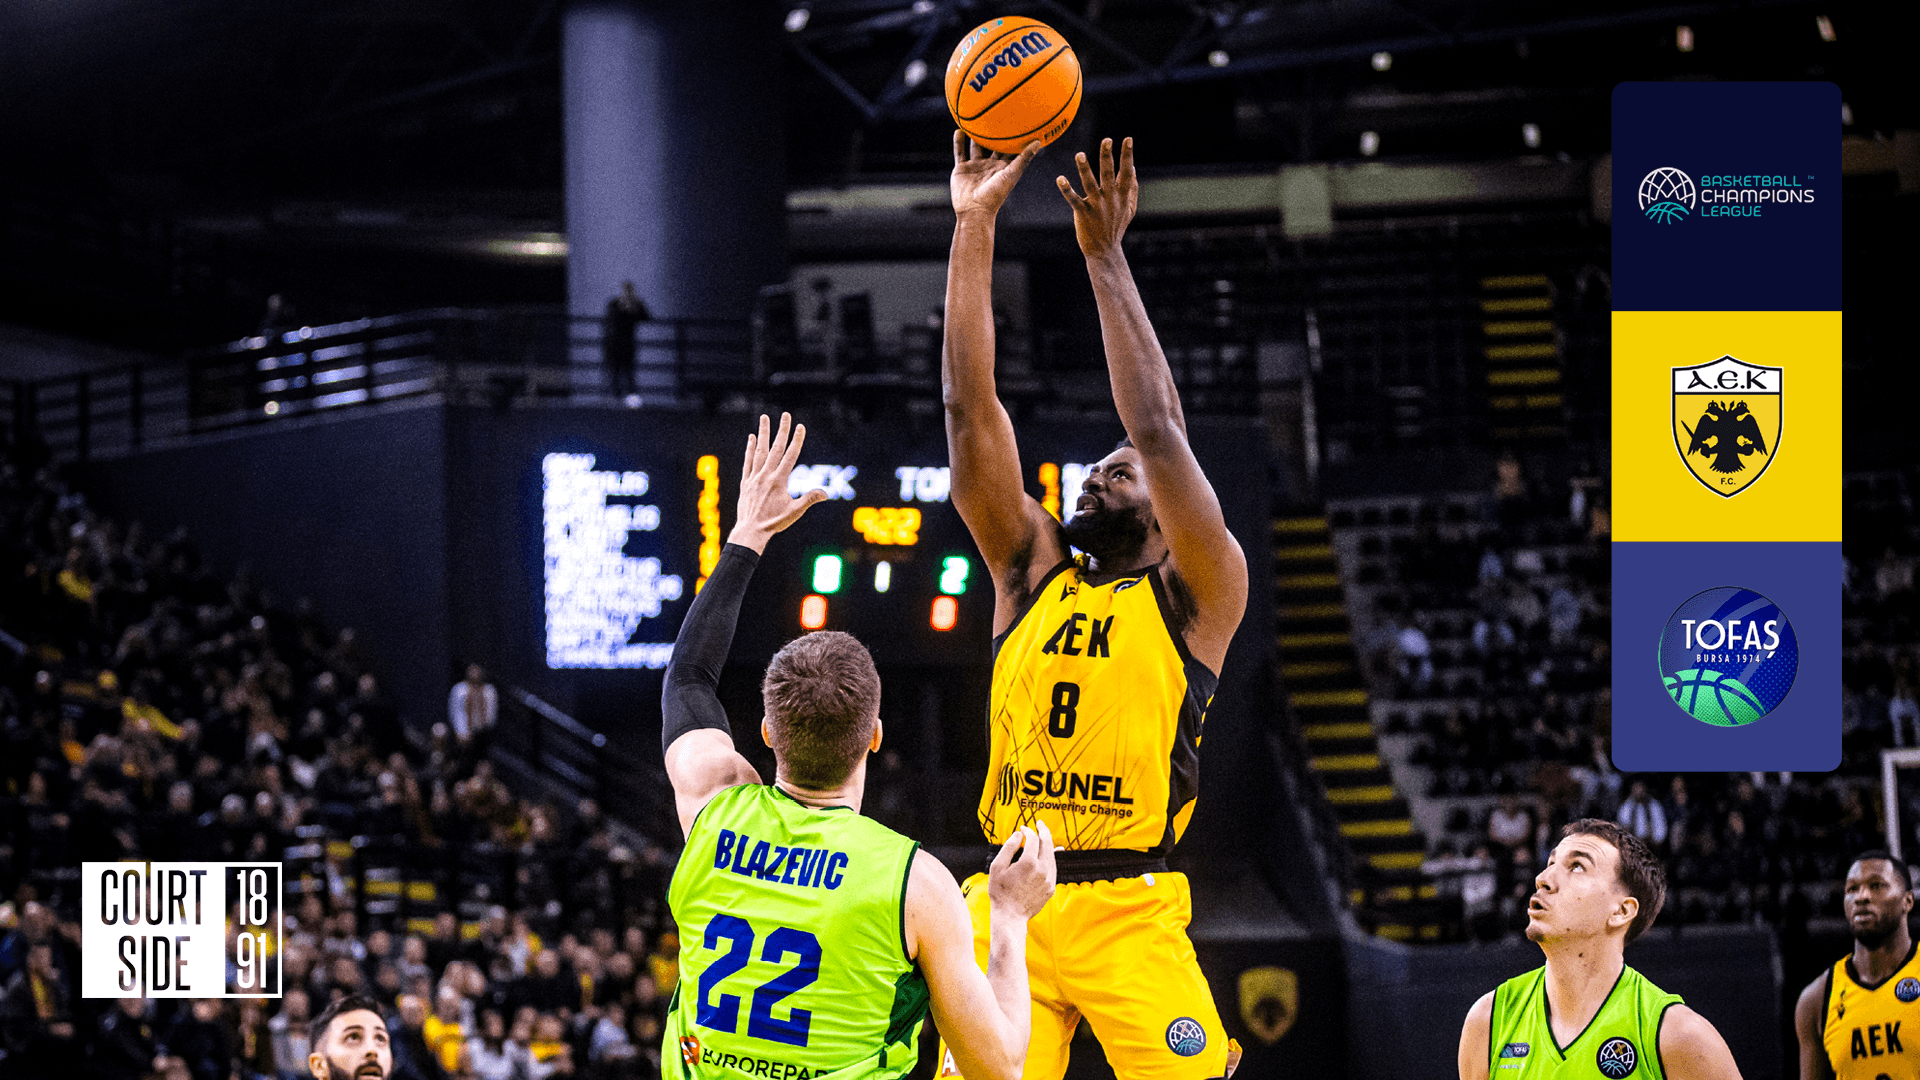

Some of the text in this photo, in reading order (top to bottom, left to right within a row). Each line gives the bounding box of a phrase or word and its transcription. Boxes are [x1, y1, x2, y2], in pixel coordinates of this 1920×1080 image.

[968, 31, 1053, 92] Wilson
[939, 556, 970, 596] 2
[1041, 612, 1115, 659] AEK
[1048, 681, 1081, 739] 8
[1020, 798, 1133, 819] Empowering Change
[1021, 769, 1134, 805] SUNEL
[713, 828, 849, 891] BLAZEVIC
[695, 912, 823, 1048] 22
[1851, 1020, 1904, 1060] AEK
